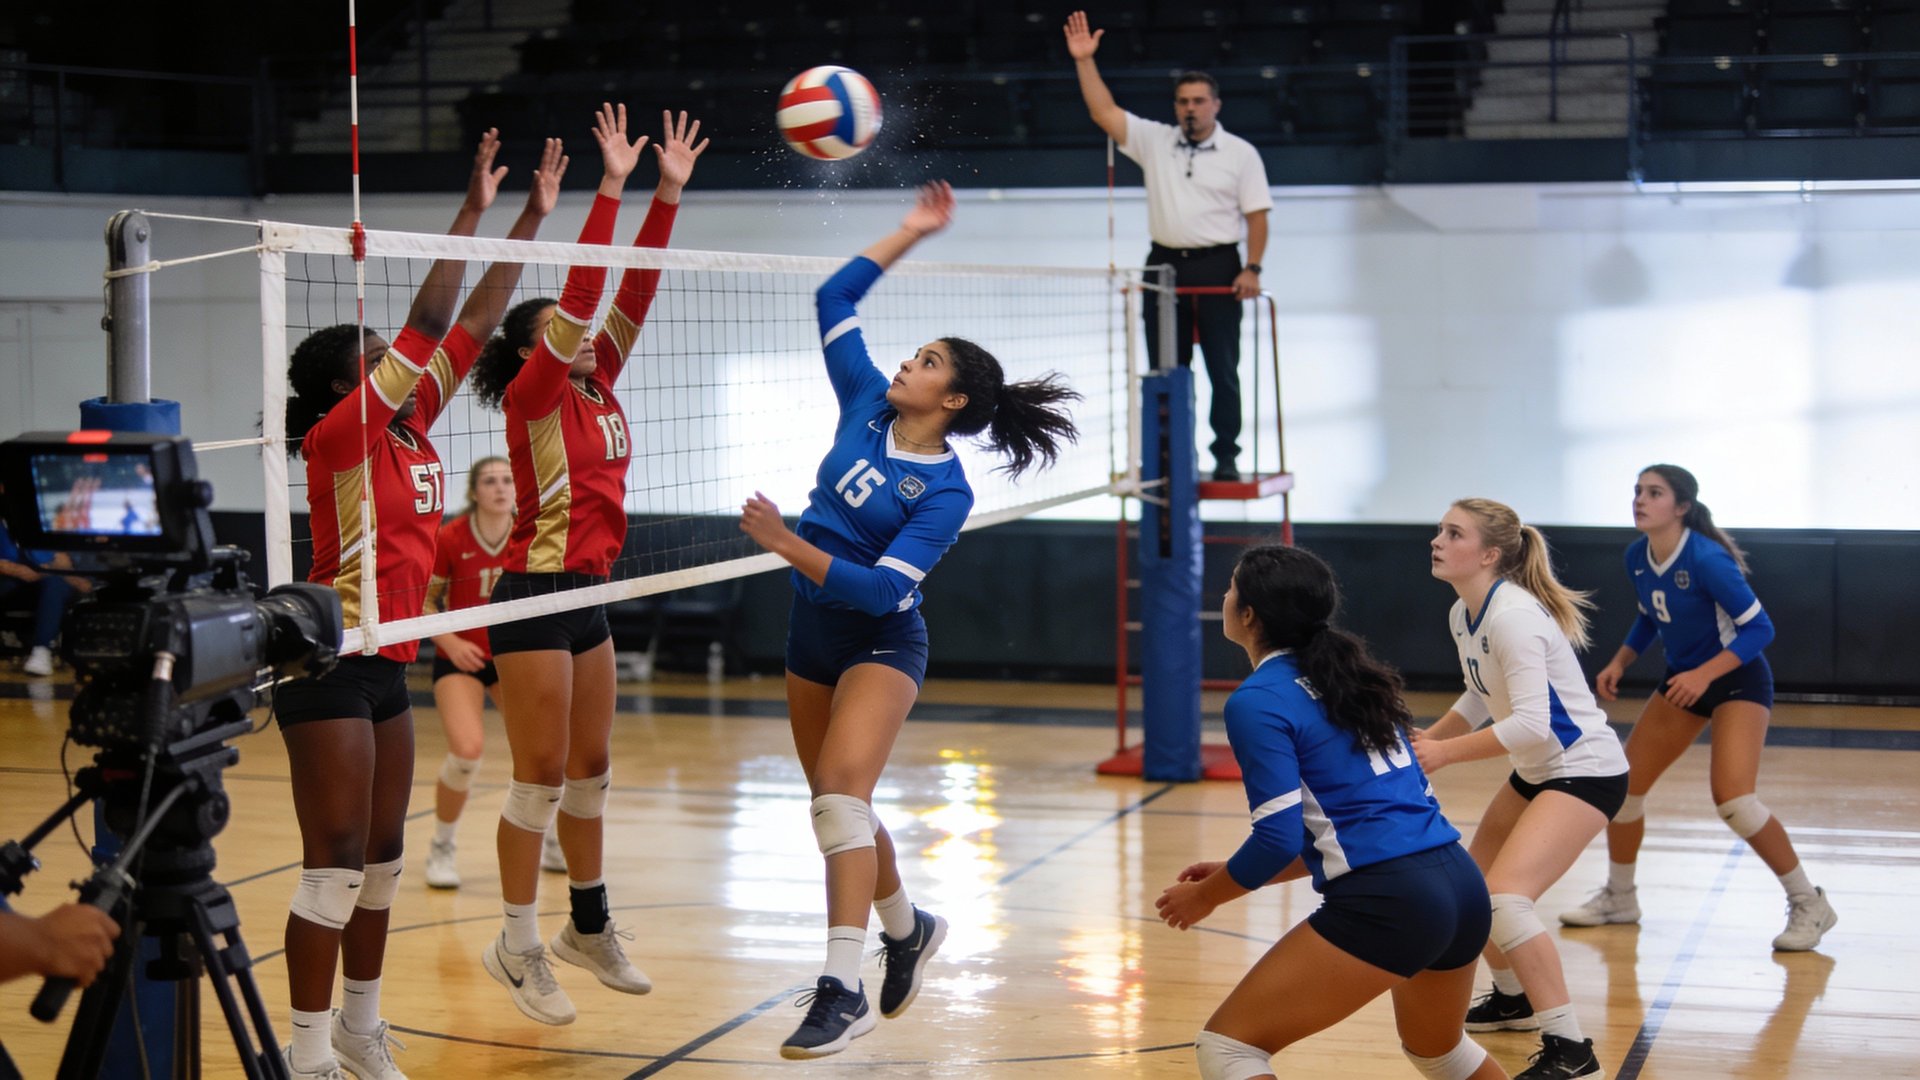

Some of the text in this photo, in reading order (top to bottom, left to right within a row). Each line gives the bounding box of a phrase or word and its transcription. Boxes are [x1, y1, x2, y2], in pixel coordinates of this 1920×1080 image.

[597, 412, 627, 460] 18
[835, 458, 886, 508] 15
[1651, 589, 1671, 623] 9
